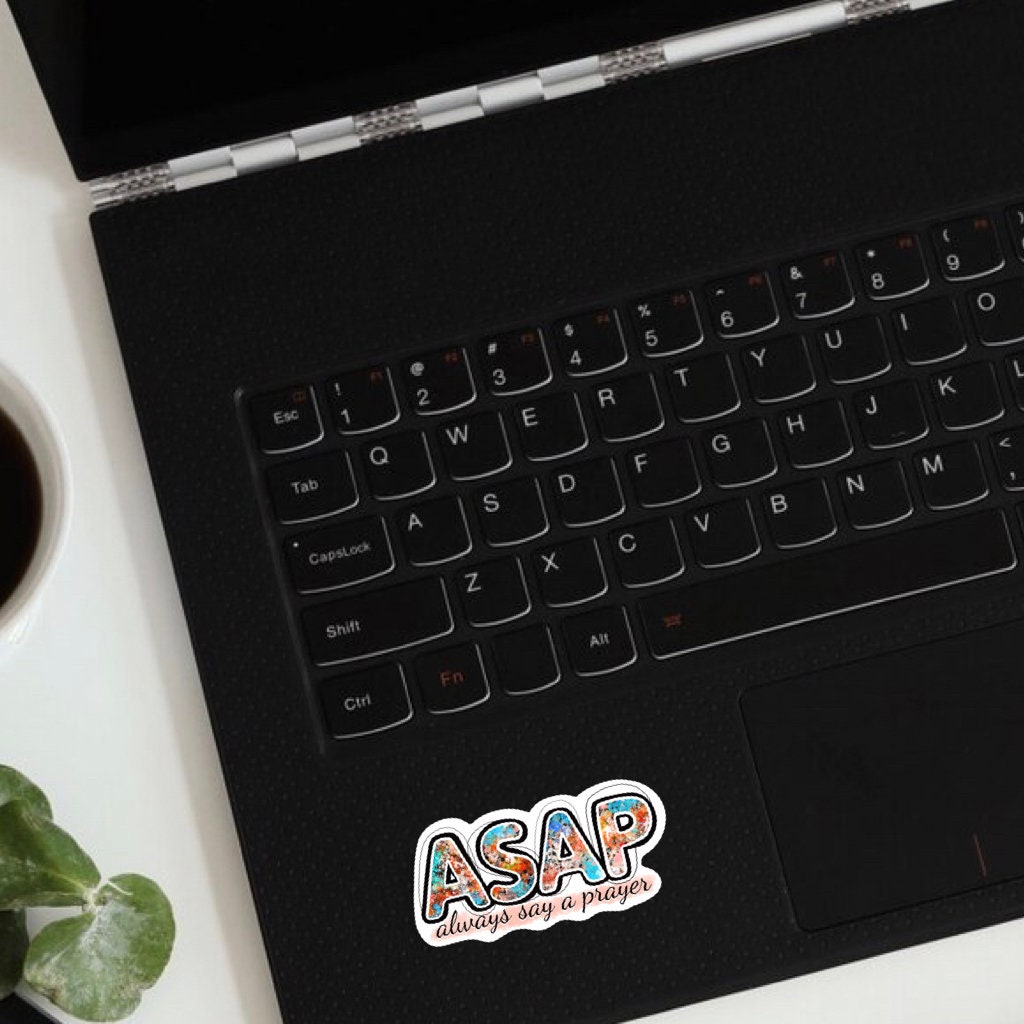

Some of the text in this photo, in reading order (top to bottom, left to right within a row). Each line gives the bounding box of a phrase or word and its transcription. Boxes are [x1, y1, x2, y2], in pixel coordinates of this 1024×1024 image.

[947, 254, 960, 271] 9
[871, 272, 884, 289] 8
[795, 292, 807, 308] 7
[976, 292, 996, 311] O
[721, 311, 734, 328] 6
[645, 330, 659, 347] 5
[824, 329, 843, 349] U
[570, 351, 582, 365] 4
[750, 348, 766, 367] Y
[493, 369, 506, 386] 3
[673, 368, 689, 387] T
[938, 376, 957, 396] K
[417, 389, 430, 407] 2
[598, 388, 616, 408] R
[866, 395, 877, 415] J
[273, 408, 299, 425] Esc
[341, 408, 351, 424] 1
[521, 407, 539, 427] E
[786, 414, 805, 434] H
[446, 424, 468, 446] W
[711, 434, 731, 453] G
[369, 446, 389, 466] Q
[633, 453, 648, 473] F
[922, 454, 944, 475] M
[290, 478, 319, 495] Tab
[557, 474, 576, 493] D
[846, 474, 865, 494] N
[483, 494, 500, 513] S
[769, 494, 788, 515] B
[407, 513, 424, 532] A
[693, 512, 710, 532] V
[618, 534, 637, 553] C
[308, 541, 371, 566] CapsLock
[542, 553, 560, 573] X
[464, 573, 482, 593] Z
[326, 619, 360, 639] Shift
[588, 633, 610, 649] Alt
[440, 671, 464, 687] Fn
[344, 692, 372, 712] Ctrl
[421, 792, 657, 925] ASAP
[436, 876, 653, 939] always say a prayer
